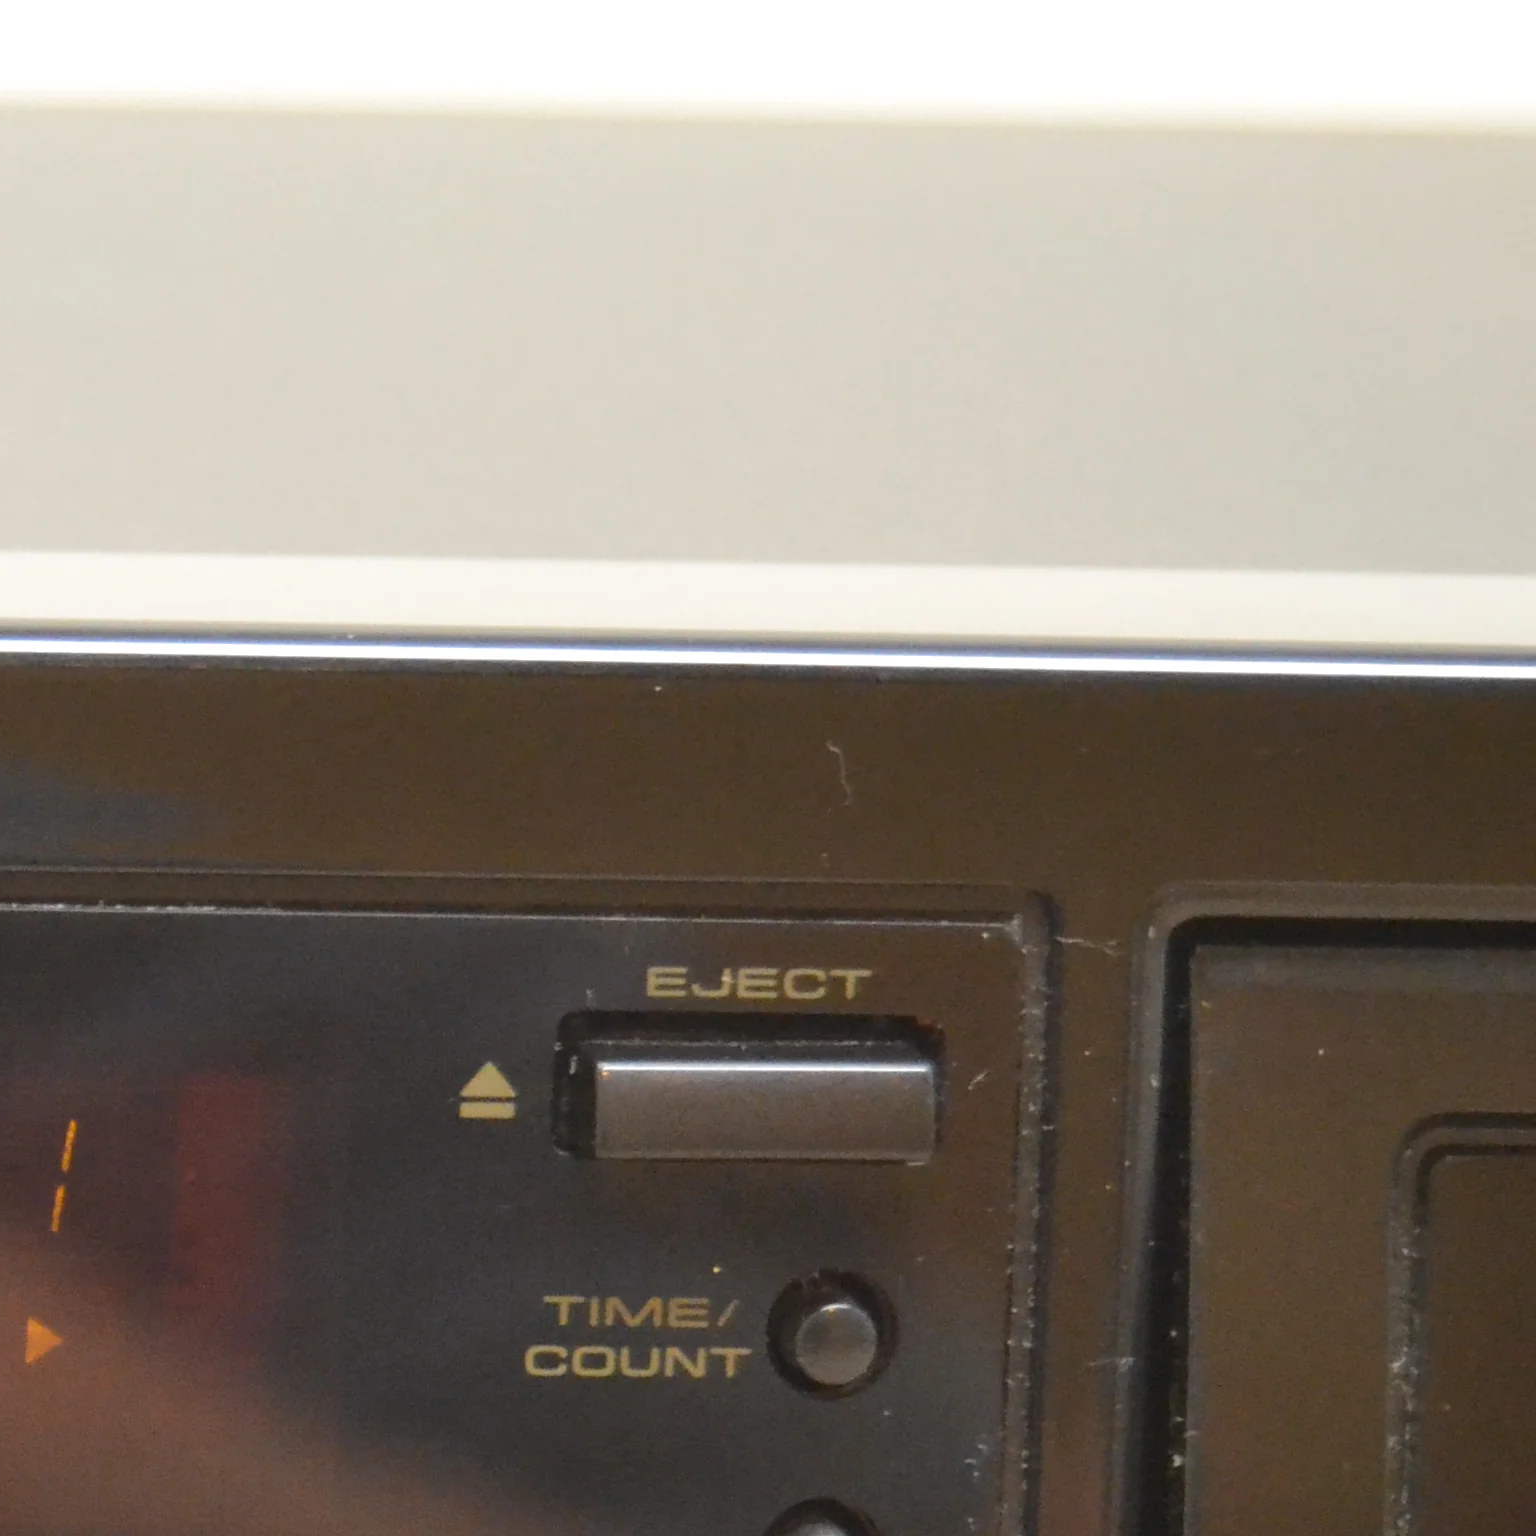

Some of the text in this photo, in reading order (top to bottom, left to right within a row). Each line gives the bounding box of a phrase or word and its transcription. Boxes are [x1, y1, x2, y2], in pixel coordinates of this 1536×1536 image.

[645, 966, 874, 1000] EJECT
[543, 1295, 740, 1330] TIME/
[523, 1346, 753, 1379] COUNT
